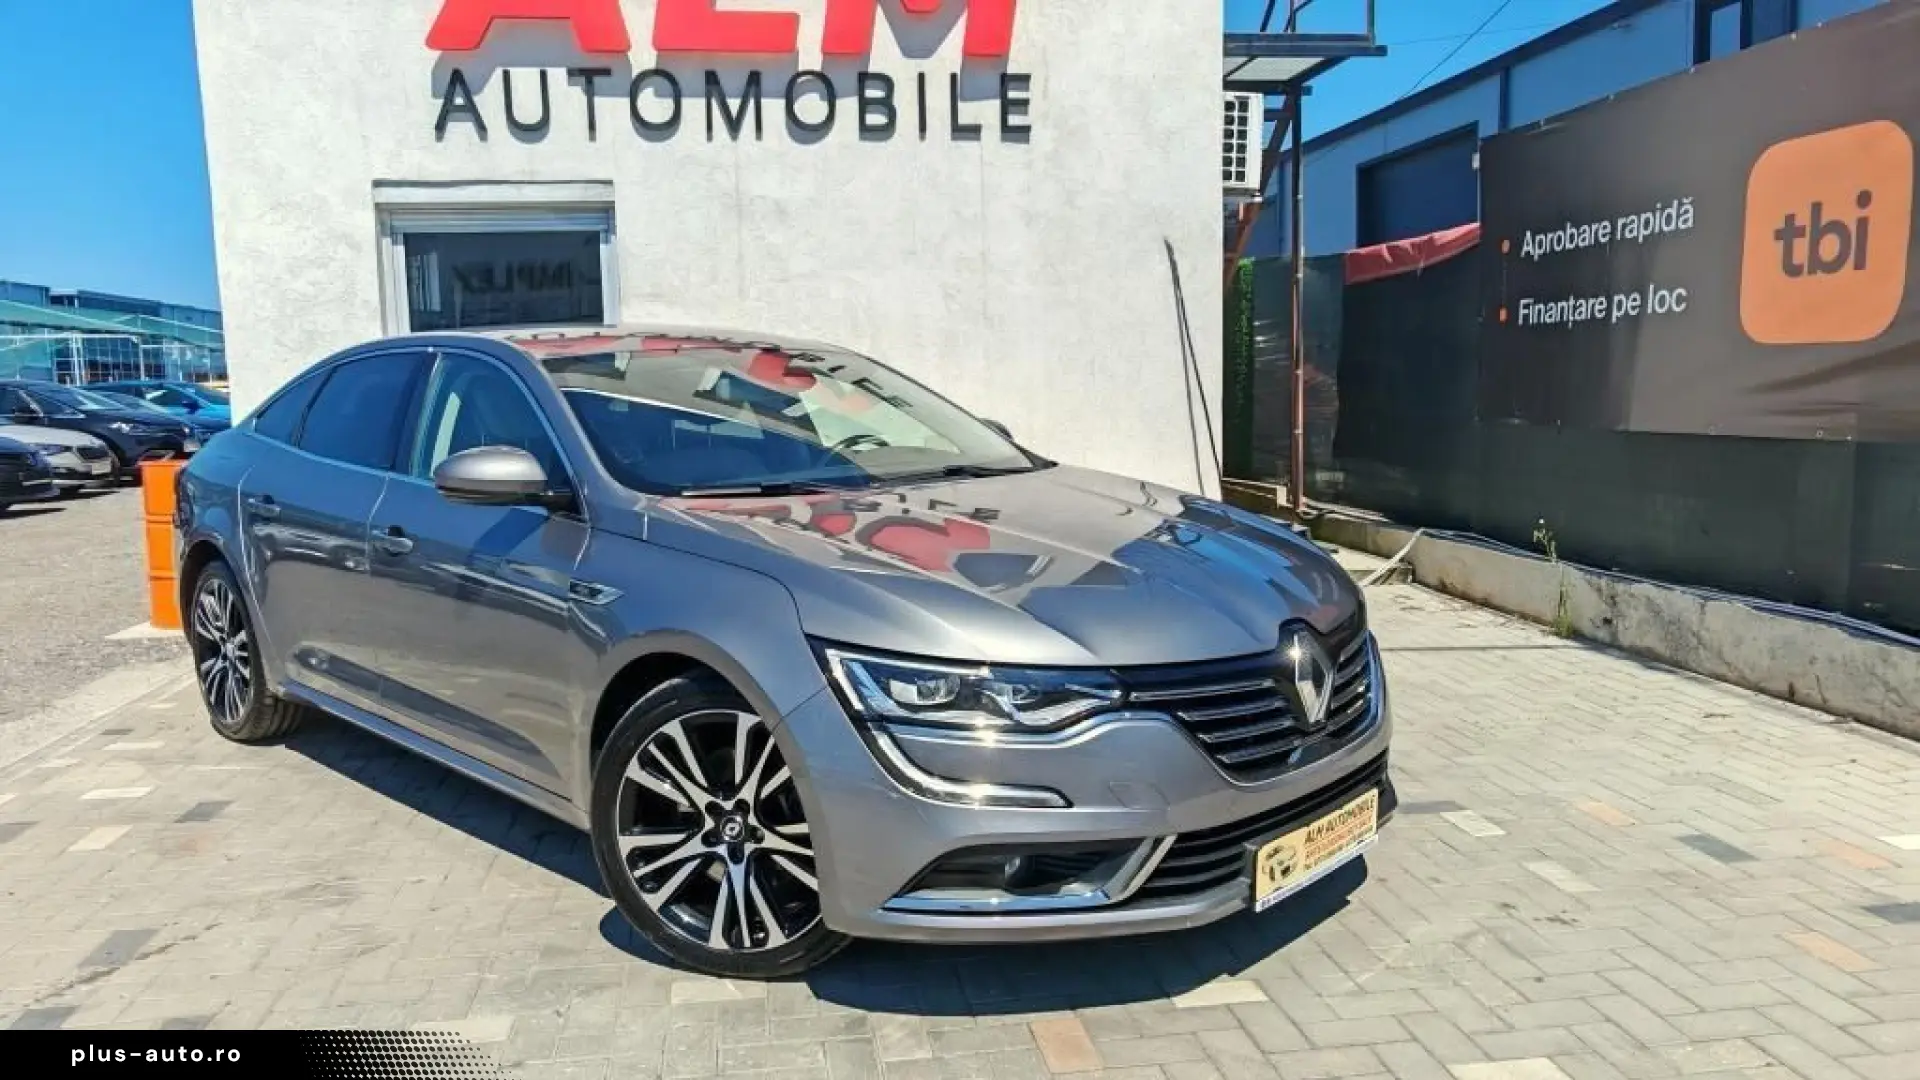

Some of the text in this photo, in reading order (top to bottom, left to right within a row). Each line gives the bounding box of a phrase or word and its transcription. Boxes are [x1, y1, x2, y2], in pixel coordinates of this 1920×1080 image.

[434, 68, 1032, 143] AUTOMOBILE
[1520, 197, 1694, 262] Aprobare rapidă
[1774, 190, 1872, 277] tbi
[1518, 284, 1688, 329] Finanțare pe loc
